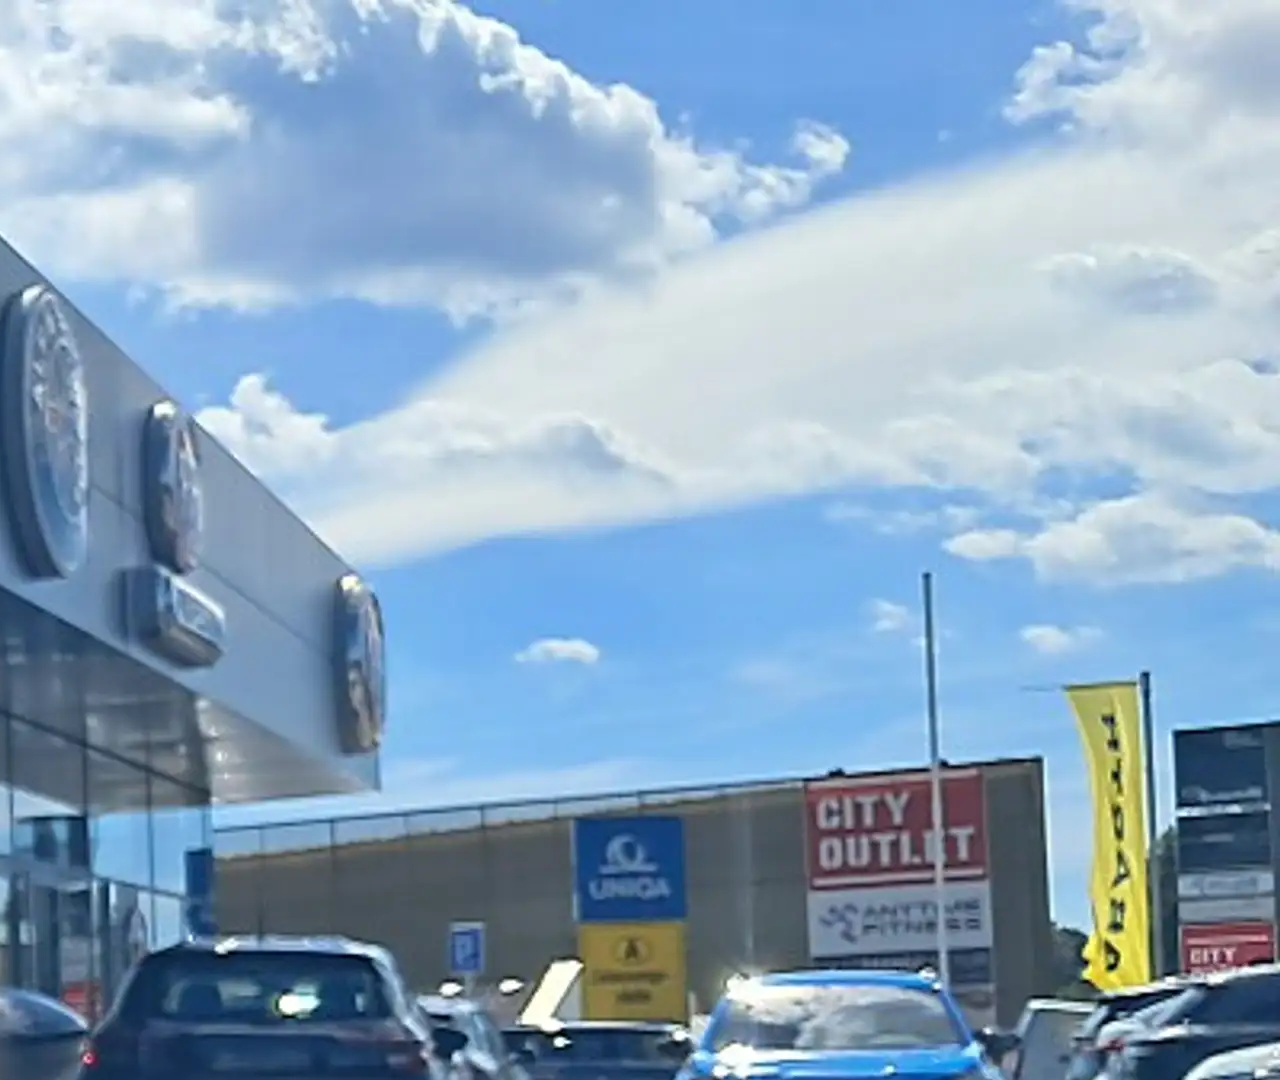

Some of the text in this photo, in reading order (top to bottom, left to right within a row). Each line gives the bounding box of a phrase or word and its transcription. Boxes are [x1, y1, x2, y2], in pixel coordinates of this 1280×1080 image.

[816, 791, 910, 830] CITY
[819, 825, 976, 871] OUTLET
[1190, 947, 1237, 965] CITY
